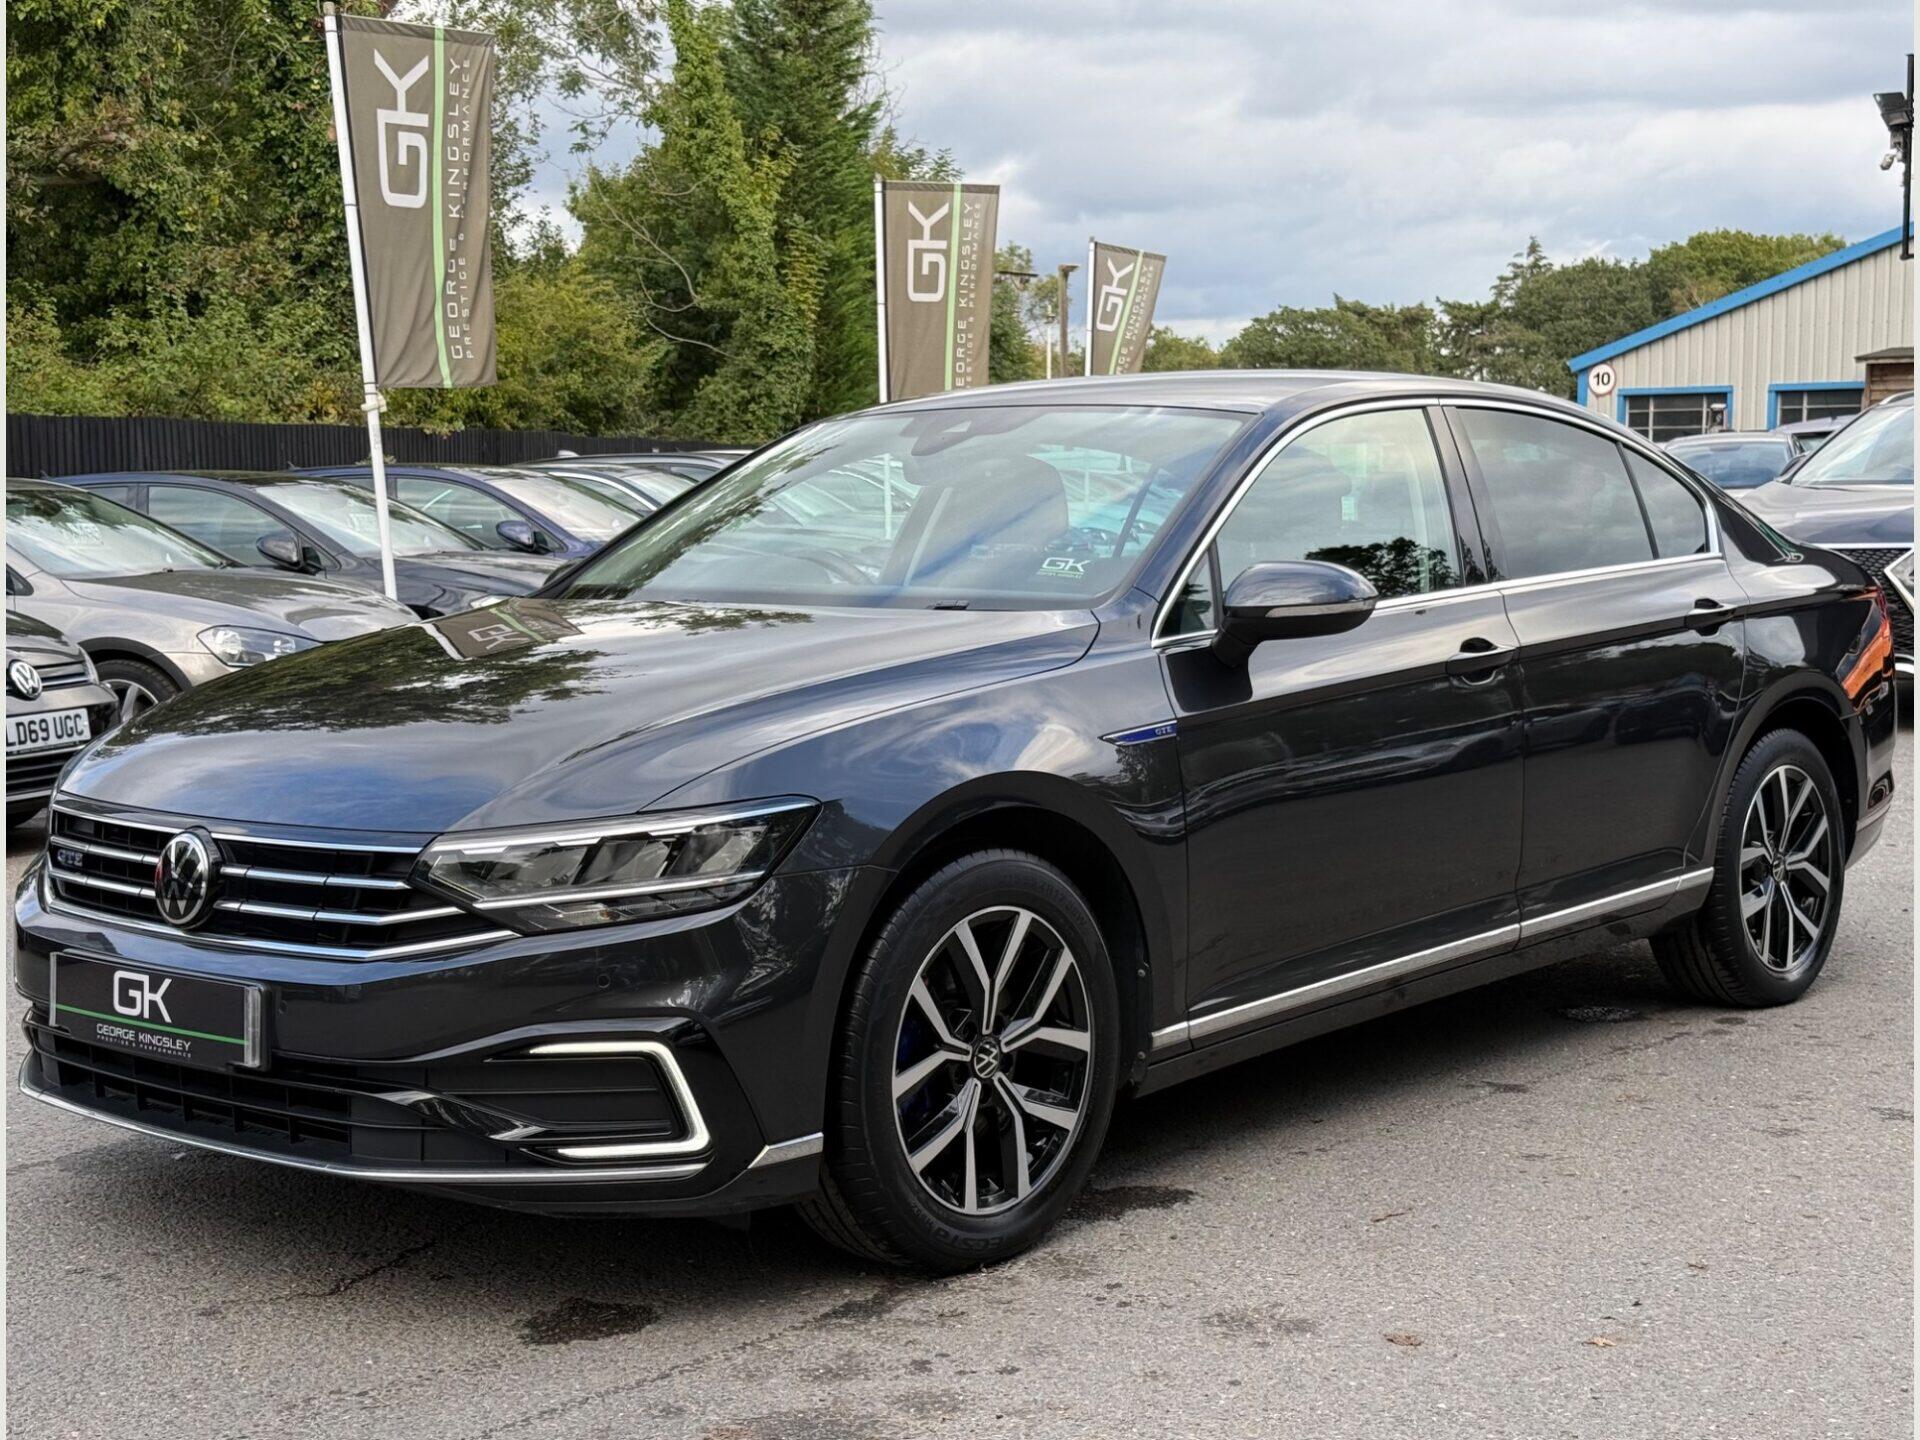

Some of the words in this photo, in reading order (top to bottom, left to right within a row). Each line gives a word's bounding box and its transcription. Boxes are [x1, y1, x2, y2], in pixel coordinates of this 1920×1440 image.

[374, 48, 429, 209] GK
[447, 58, 461, 219] KINGSLEY
[460, 59, 472, 219] RFORMANCE
[907, 200, 950, 302] GK
[958, 202, 974, 308] KINGSLEY
[1096, 257, 1135, 332] GK
[446, 238, 463, 359] GEORGE
[458, 256, 474, 359] PRESTIGE
[955, 319, 967, 387] EORGE
[1593, 371, 1611, 386] 10
[1042, 557, 1090, 572] GK
[6, 718, 50, 748] LD69
[53, 713, 84, 740] UGC
[96, 1023, 136, 1041] GEORGE
[138, 1032, 191, 1051] KINGSLEY
[113, 970, 172, 1023] GK
